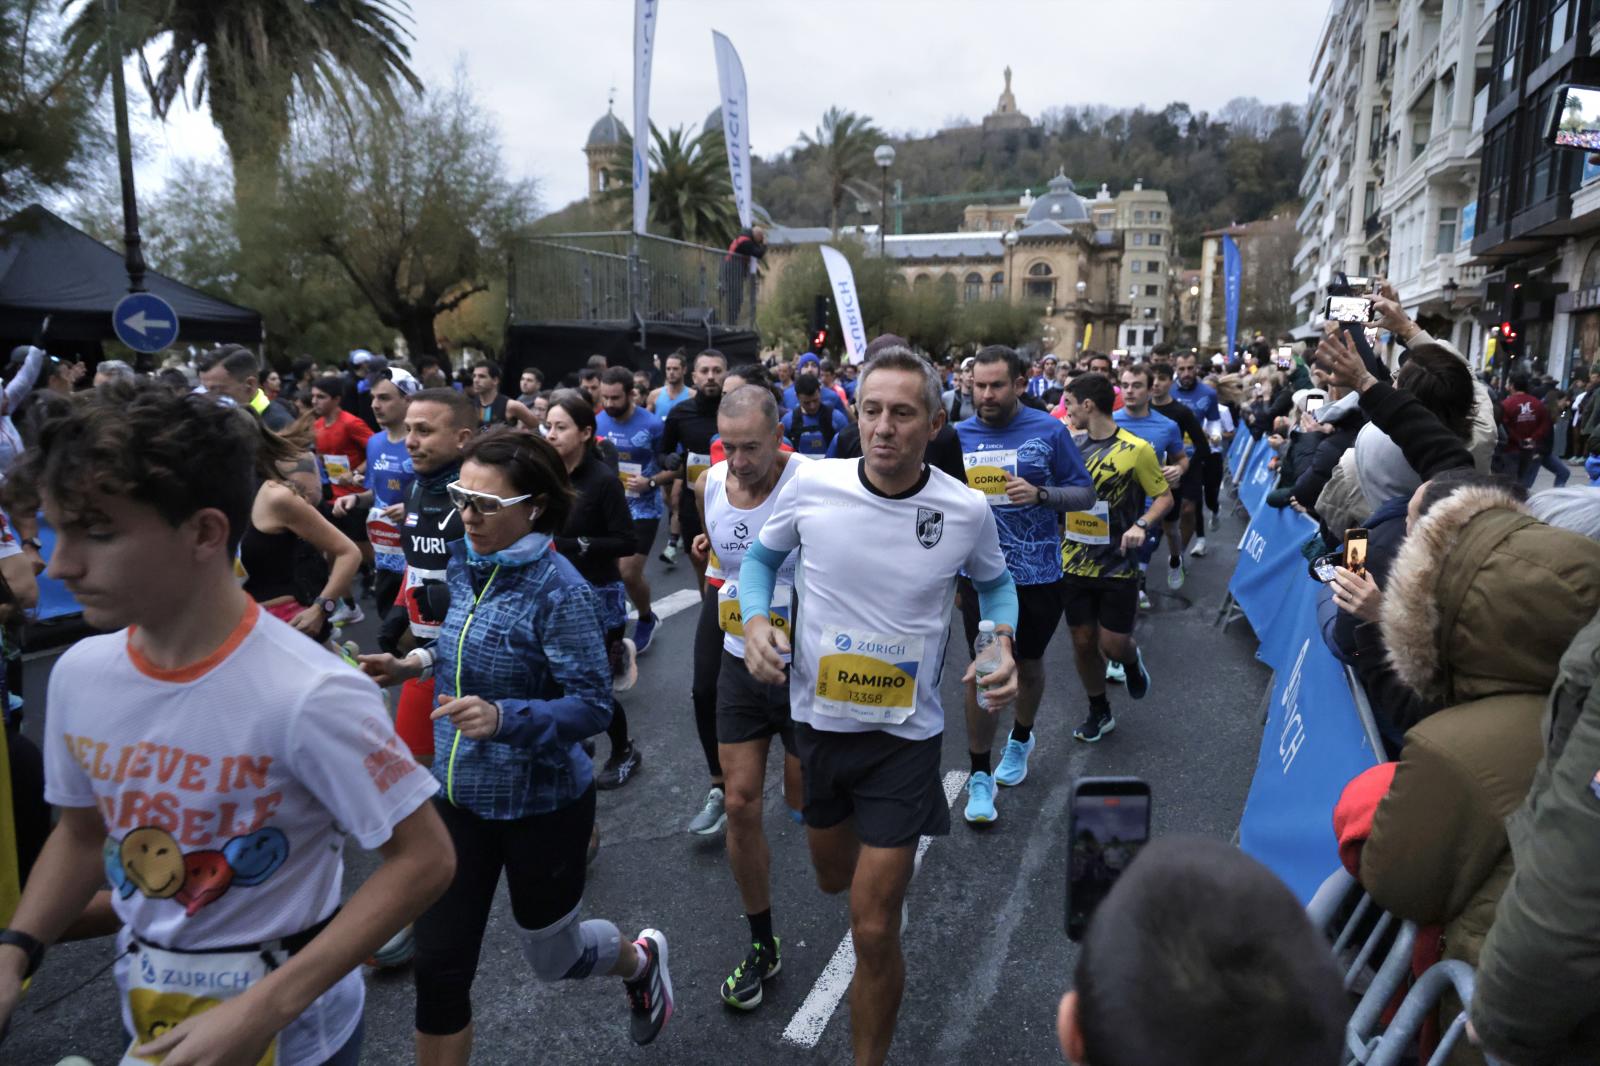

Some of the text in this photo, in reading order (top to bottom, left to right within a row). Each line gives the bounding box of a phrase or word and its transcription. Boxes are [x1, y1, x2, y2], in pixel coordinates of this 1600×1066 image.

[980, 455, 1006, 464] ZURICH
[974, 475, 1008, 485] GORKA
[1075, 519, 1099, 528] AITOR
[410, 534, 447, 555] YURI
[857, 641, 906, 656] ZURICH
[837, 670, 906, 689] RAMIRO
[849, 690, 883, 705] 13358
[216, 755, 273, 794] IN
[162, 968, 251, 990] ZURICH
